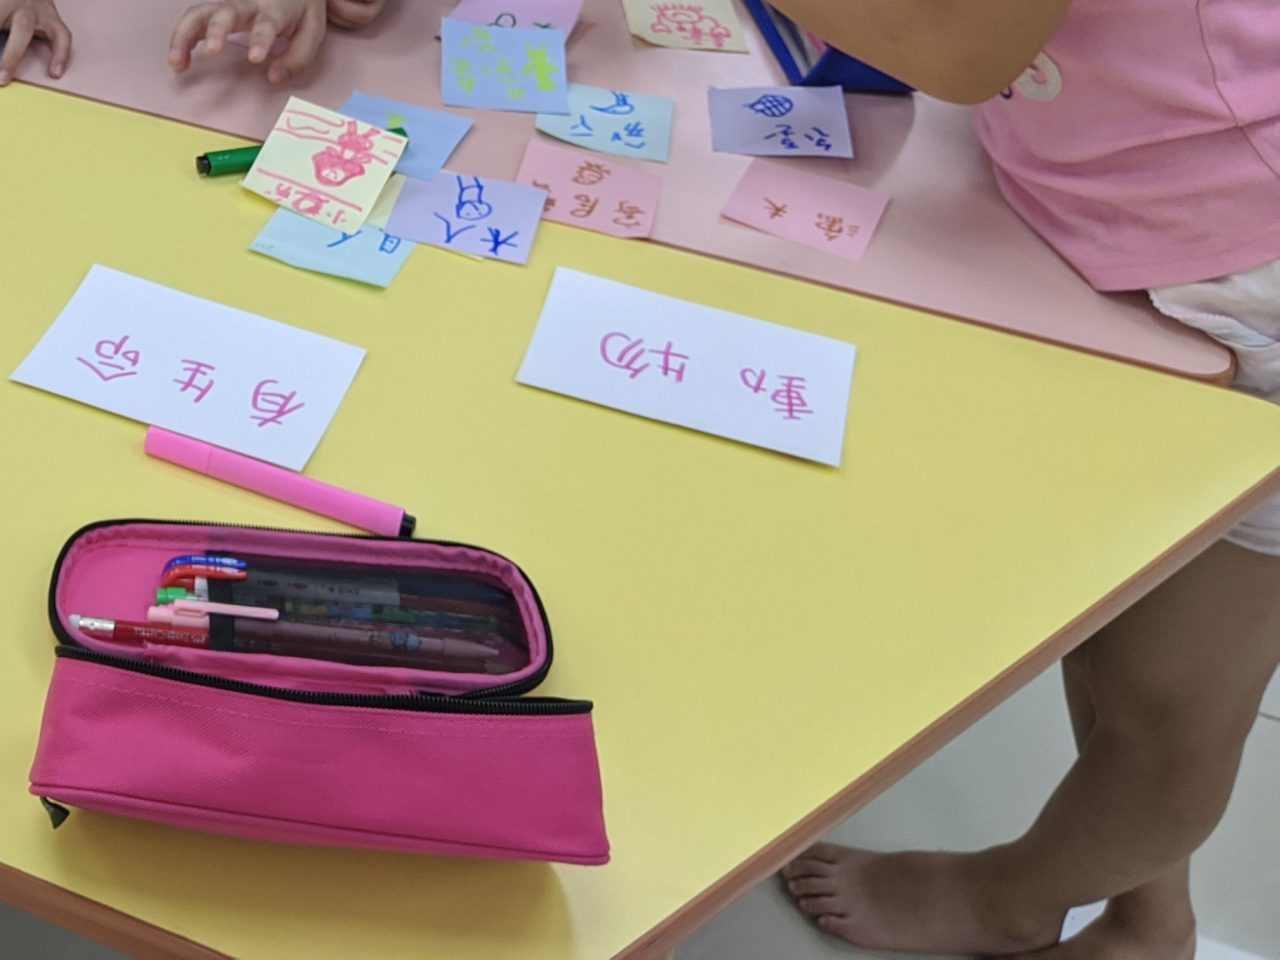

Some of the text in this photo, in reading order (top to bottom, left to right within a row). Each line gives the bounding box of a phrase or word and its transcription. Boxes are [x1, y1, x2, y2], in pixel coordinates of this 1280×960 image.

[76, 334, 306, 428] 有生命
[599, 331, 815, 420] 動物
